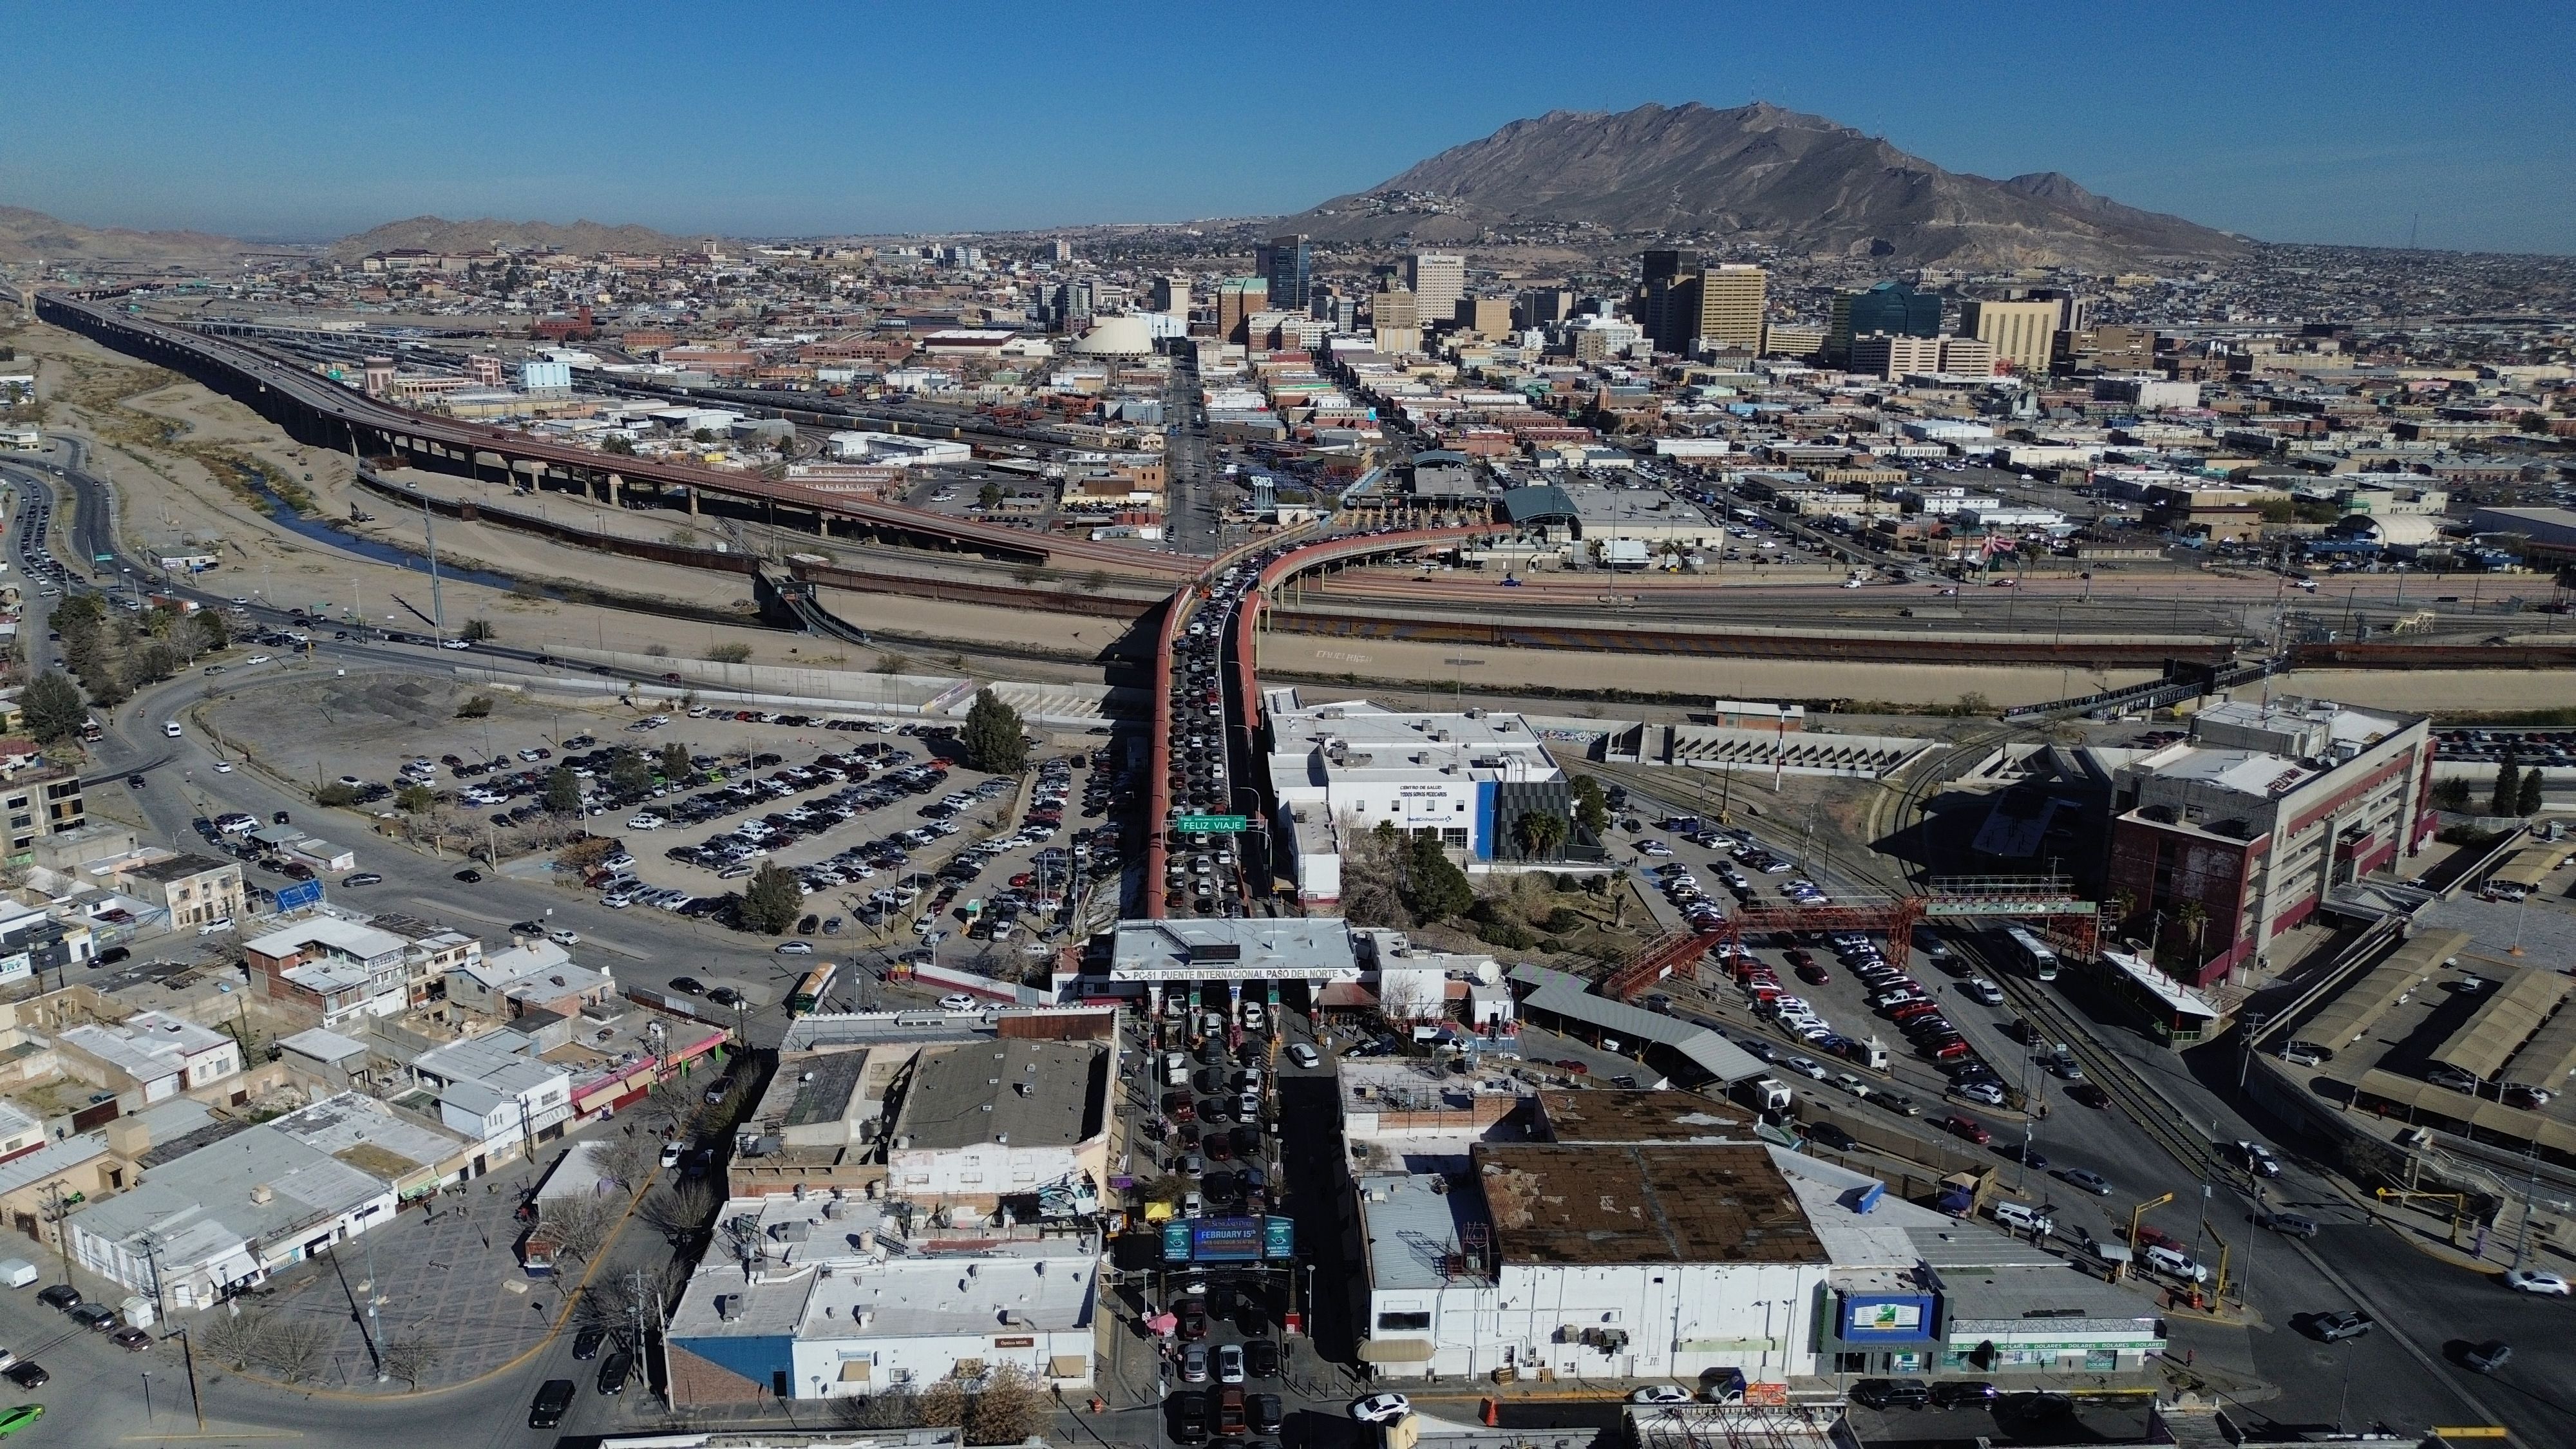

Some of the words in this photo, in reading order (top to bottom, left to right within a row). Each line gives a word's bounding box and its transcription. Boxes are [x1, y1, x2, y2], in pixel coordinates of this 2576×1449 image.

[1133, 971, 1156, 980] PC-51
[1161, 971, 1194, 979] PUENTE
[1197, 970, 1264, 979] INTERNACIONAL
[1266, 969, 1289, 978] PASO
[1291, 969, 1307, 978] DEL
[1309, 969, 1338, 978] NORTE
[1201, 1230, 1242, 1238] FEBRUARY
